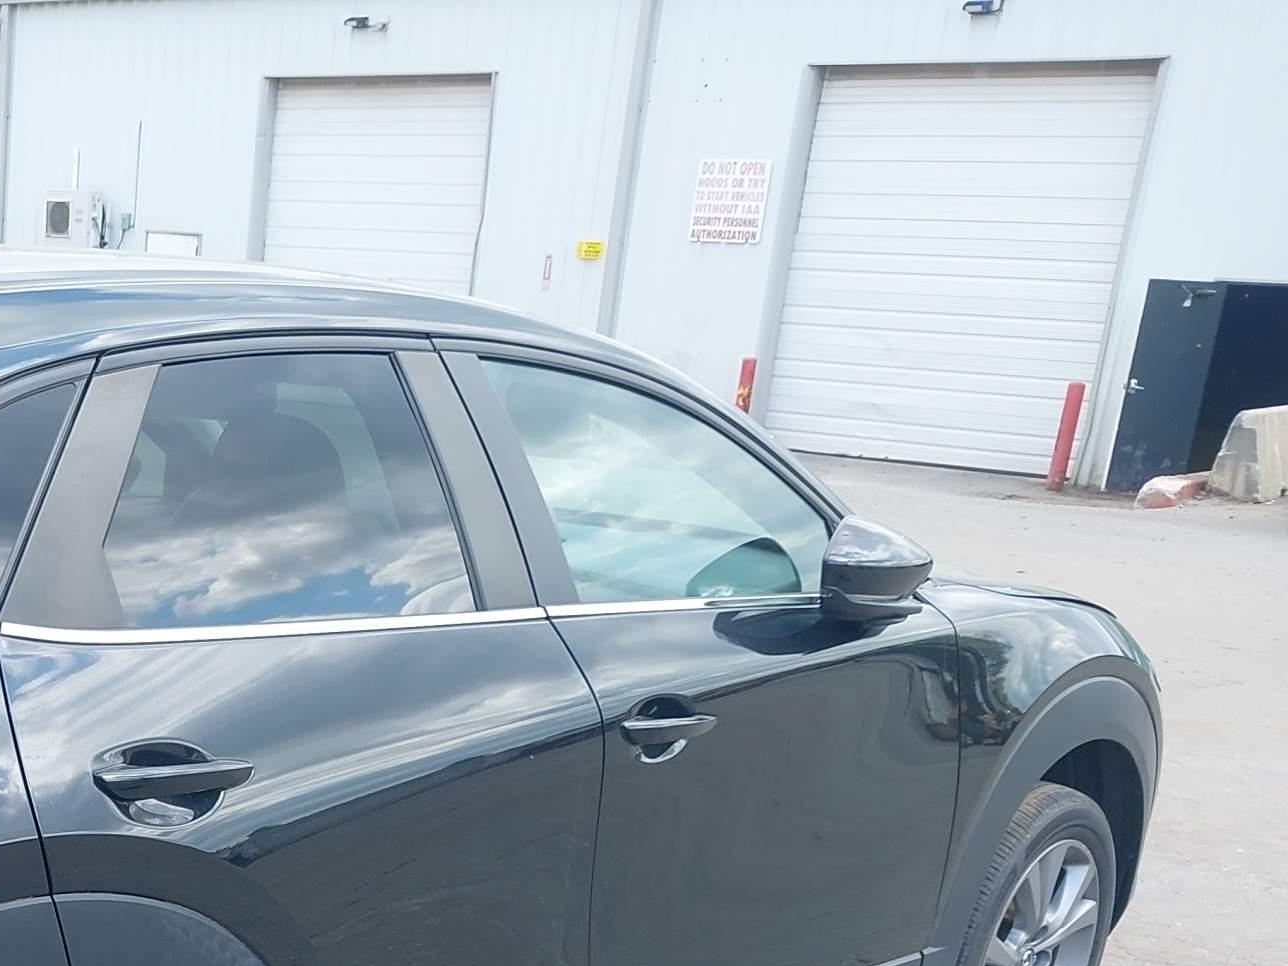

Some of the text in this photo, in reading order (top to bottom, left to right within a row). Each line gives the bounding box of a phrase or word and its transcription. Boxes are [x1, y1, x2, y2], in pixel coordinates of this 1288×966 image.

[702, 161, 767, 176] DO NOT OPEN
[698, 178, 766, 189] HOODS OR TRY
[696, 190, 764, 202] TO START VEHICLES
[695, 203, 760, 214] WITHOUT IAA
[692, 216, 759, 228] SECURITY PERSONNEL
[689, 228, 757, 240] AUTHORIZATION
